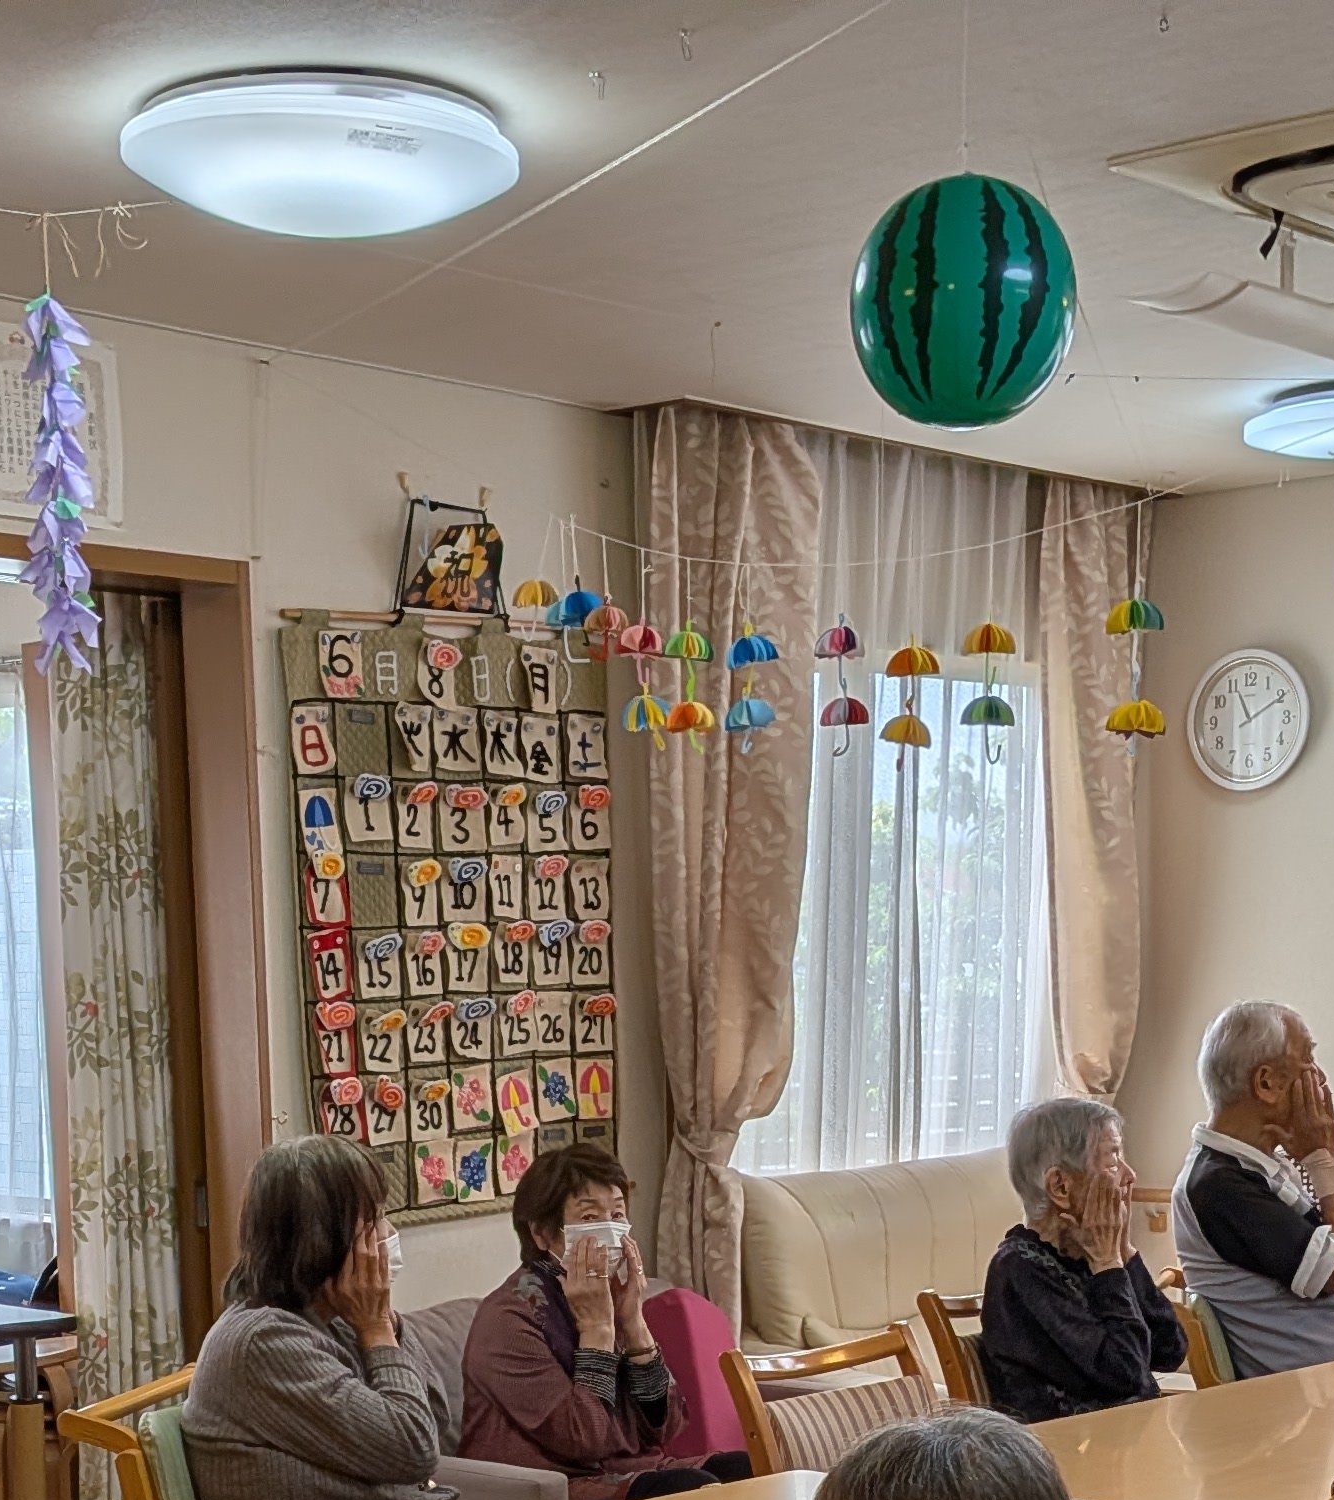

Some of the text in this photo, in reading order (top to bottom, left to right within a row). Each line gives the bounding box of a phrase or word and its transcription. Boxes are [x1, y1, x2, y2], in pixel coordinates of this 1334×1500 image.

[441, 550, 474, 598] 祝
[1228, 679, 1238, 693] 11
[1244, 671, 1258, 687] 12
[1266, 676, 1271, 690] 1
[1214, 694, 1227, 709] 10
[1276, 688, 1286, 704] 2
[1209, 715, 1218, 731] 9
[1282, 709, 1291, 725] 3
[1215, 735, 1224, 750] 8
[1276, 730, 1284, 746] 4
[301, 725, 328, 766] 日
[441, 723, 476, 763] 水
[489, 722, 515, 765] 木
[530, 741, 553, 775] 金
[572, 731, 602, 769] 土
[1263, 746, 1272, 762] 5
[1229, 749, 1237, 765] 7
[1244, 753, 1254, 769] 6
[359, 798, 599, 844] 1 2 3 4 5 6
[312, 874, 602, 919] 7 9 10 11 12 13
[315, 940, 603, 992] 14 15 16 17 18 19 20
[322, 1013, 606, 1064] 21 22 23 24 25 26 27
[327, 1101, 443, 1135] 28 29 30
